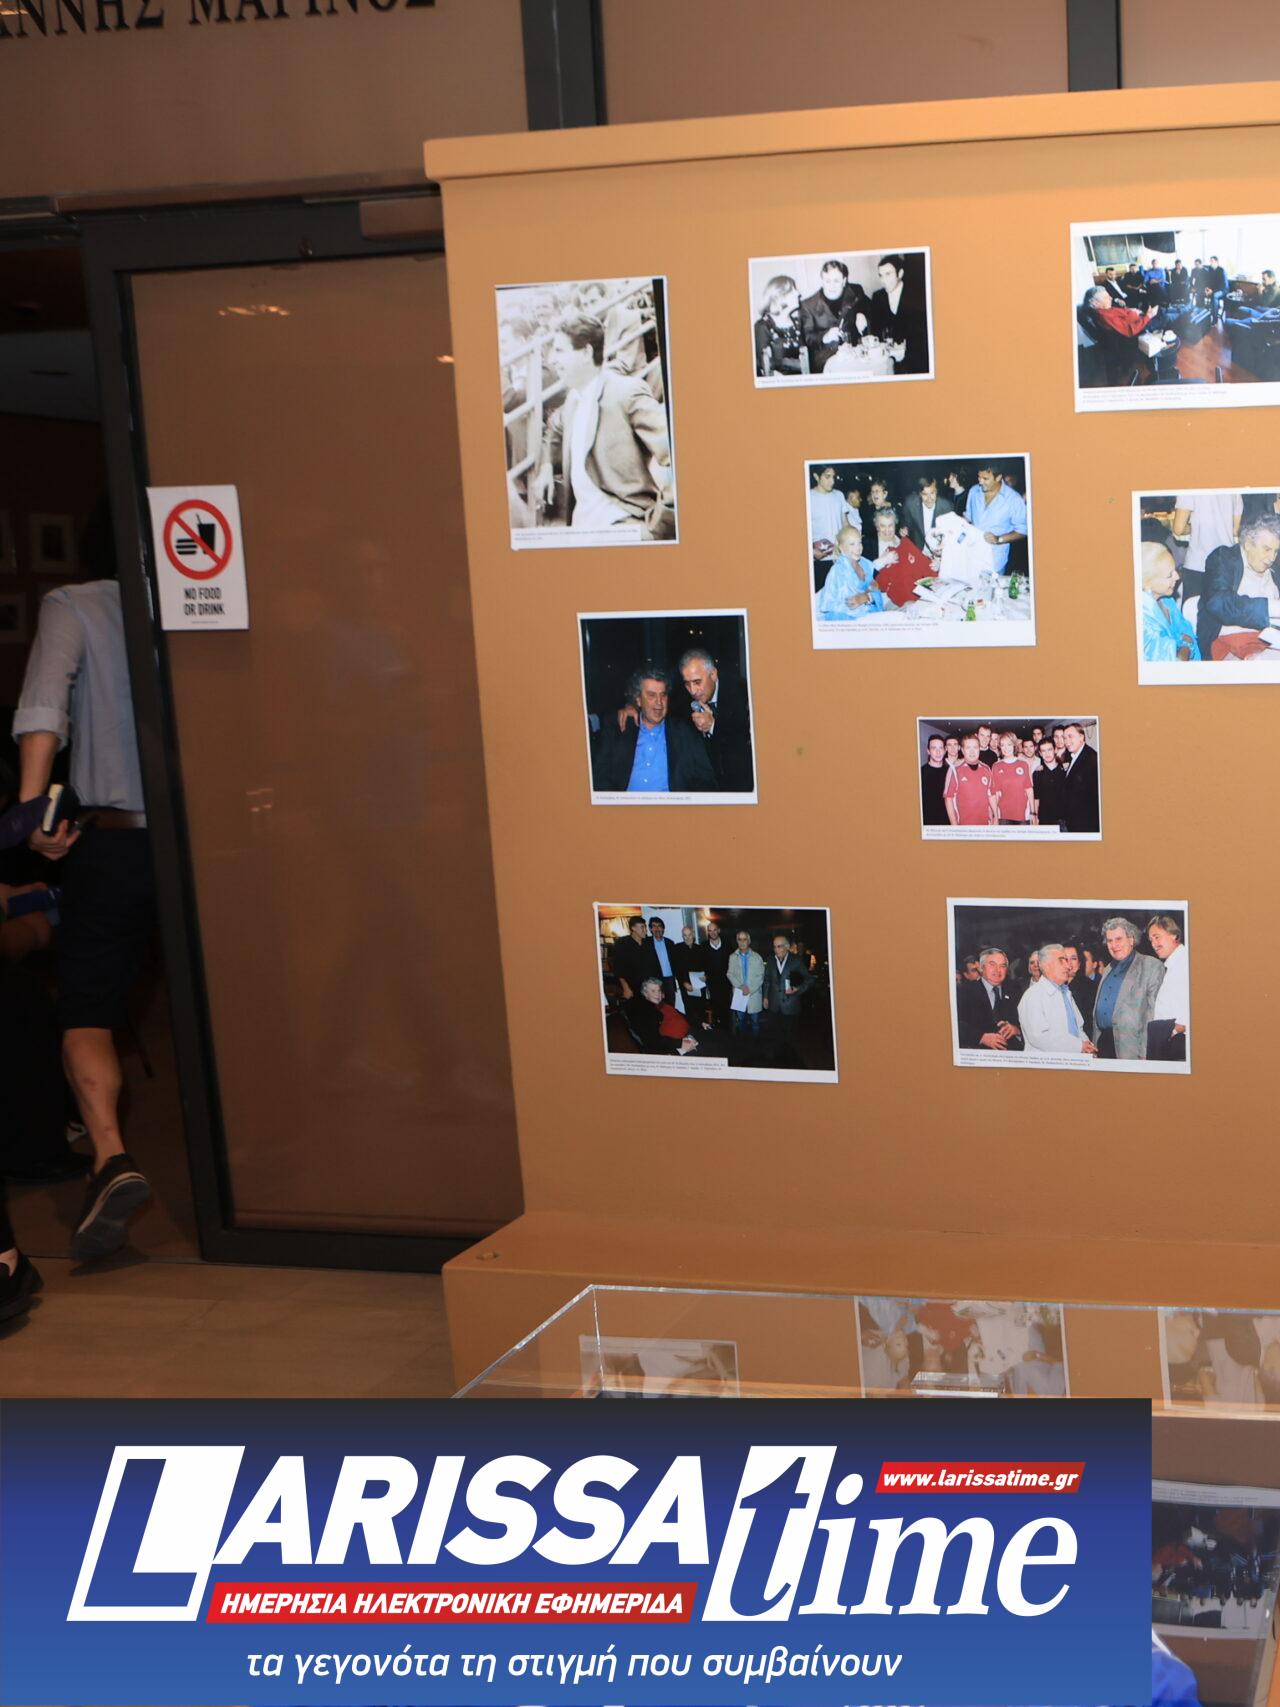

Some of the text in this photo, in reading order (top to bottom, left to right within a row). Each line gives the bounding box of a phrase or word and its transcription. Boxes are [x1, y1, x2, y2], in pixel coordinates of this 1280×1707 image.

[184, 587, 222, 600] NO FOOD
[184, 603, 226, 616] OR DRINK
